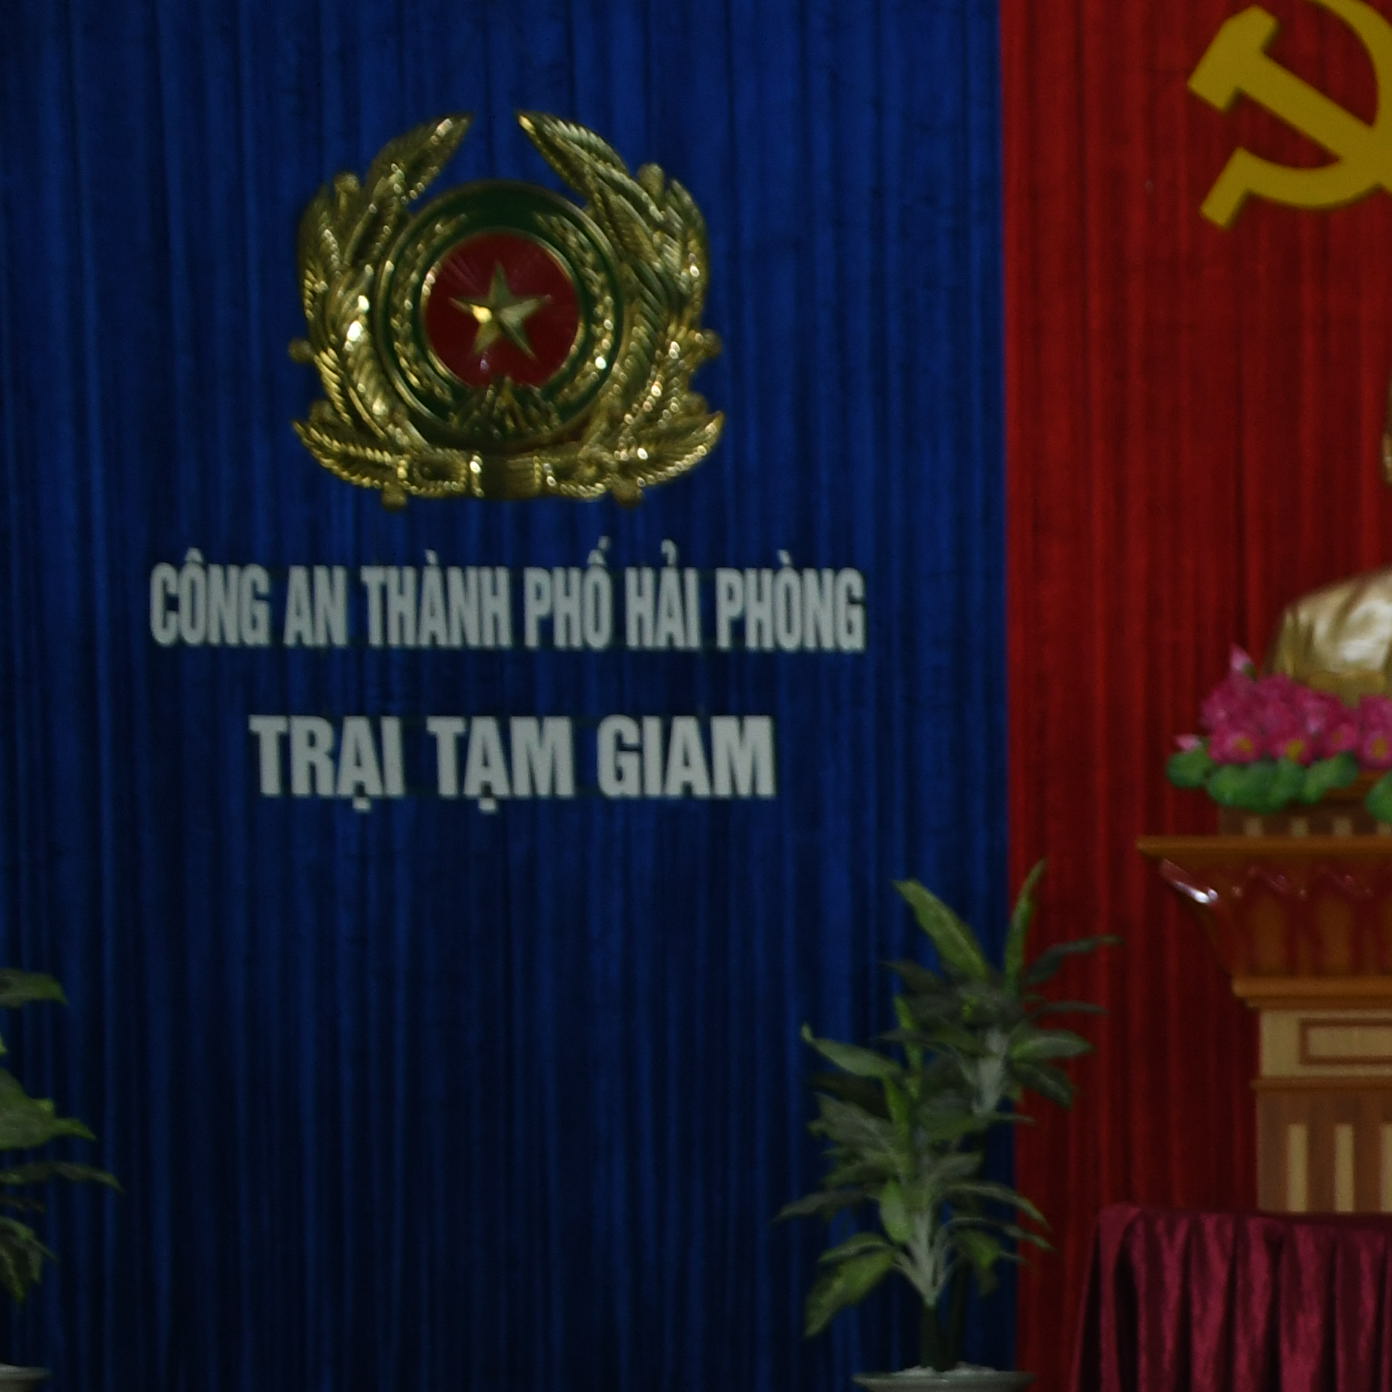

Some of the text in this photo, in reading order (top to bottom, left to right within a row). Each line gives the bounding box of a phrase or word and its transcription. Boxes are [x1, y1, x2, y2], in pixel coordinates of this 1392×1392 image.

[150, 536, 866, 652] CÔNG AN THÀNH PHỐ HẢI PHÒNG
[249, 714, 777, 812] TRẠI TẠM GIAM
